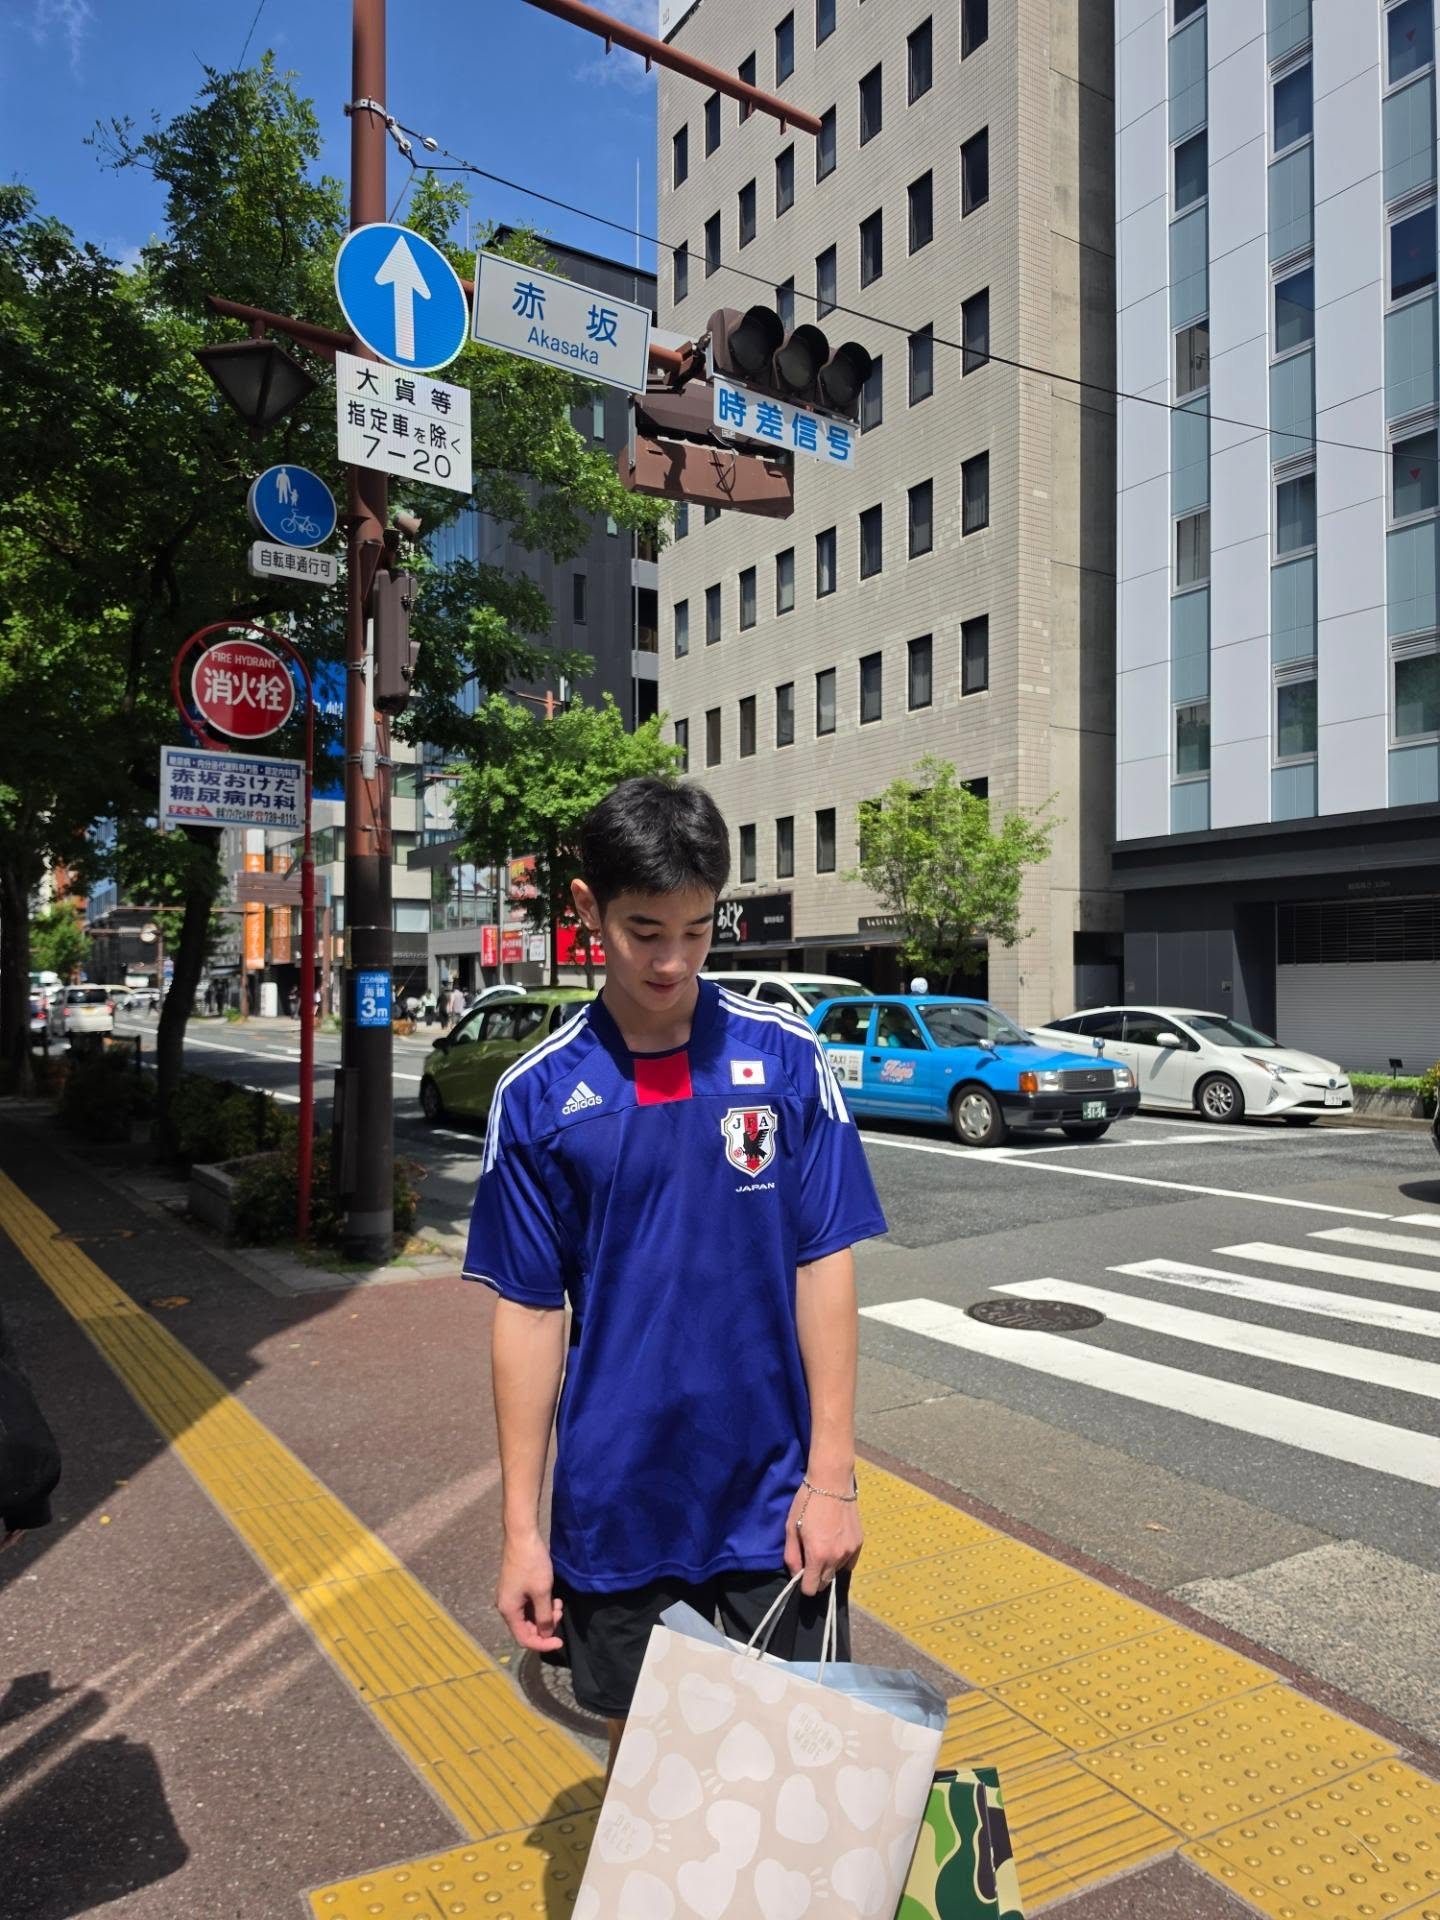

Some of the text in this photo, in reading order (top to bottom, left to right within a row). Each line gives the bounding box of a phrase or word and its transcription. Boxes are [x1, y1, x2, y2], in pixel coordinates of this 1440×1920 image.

[512, 281, 618, 348] 赤坂
[527, 326, 600, 366] Akasaka
[356, 367, 452, 416] 大貨等
[347, 400, 461, 455] 指定車を除く
[719, 388, 851, 462] 時差信号
[261, 549, 331, 577] 自転車通行可
[211, 651, 277, 669] FIRE HYDRANT
[204, 666, 285, 712] 消火栓
[171, 769, 295, 793] 赤坂おけだ
[170, 785, 296, 811] 糖尿病内科
[562, 1094, 604, 1115] adidas
[732, 1115, 769, 1130] JFA
[735, 1182, 776, 1193] JAPAN
